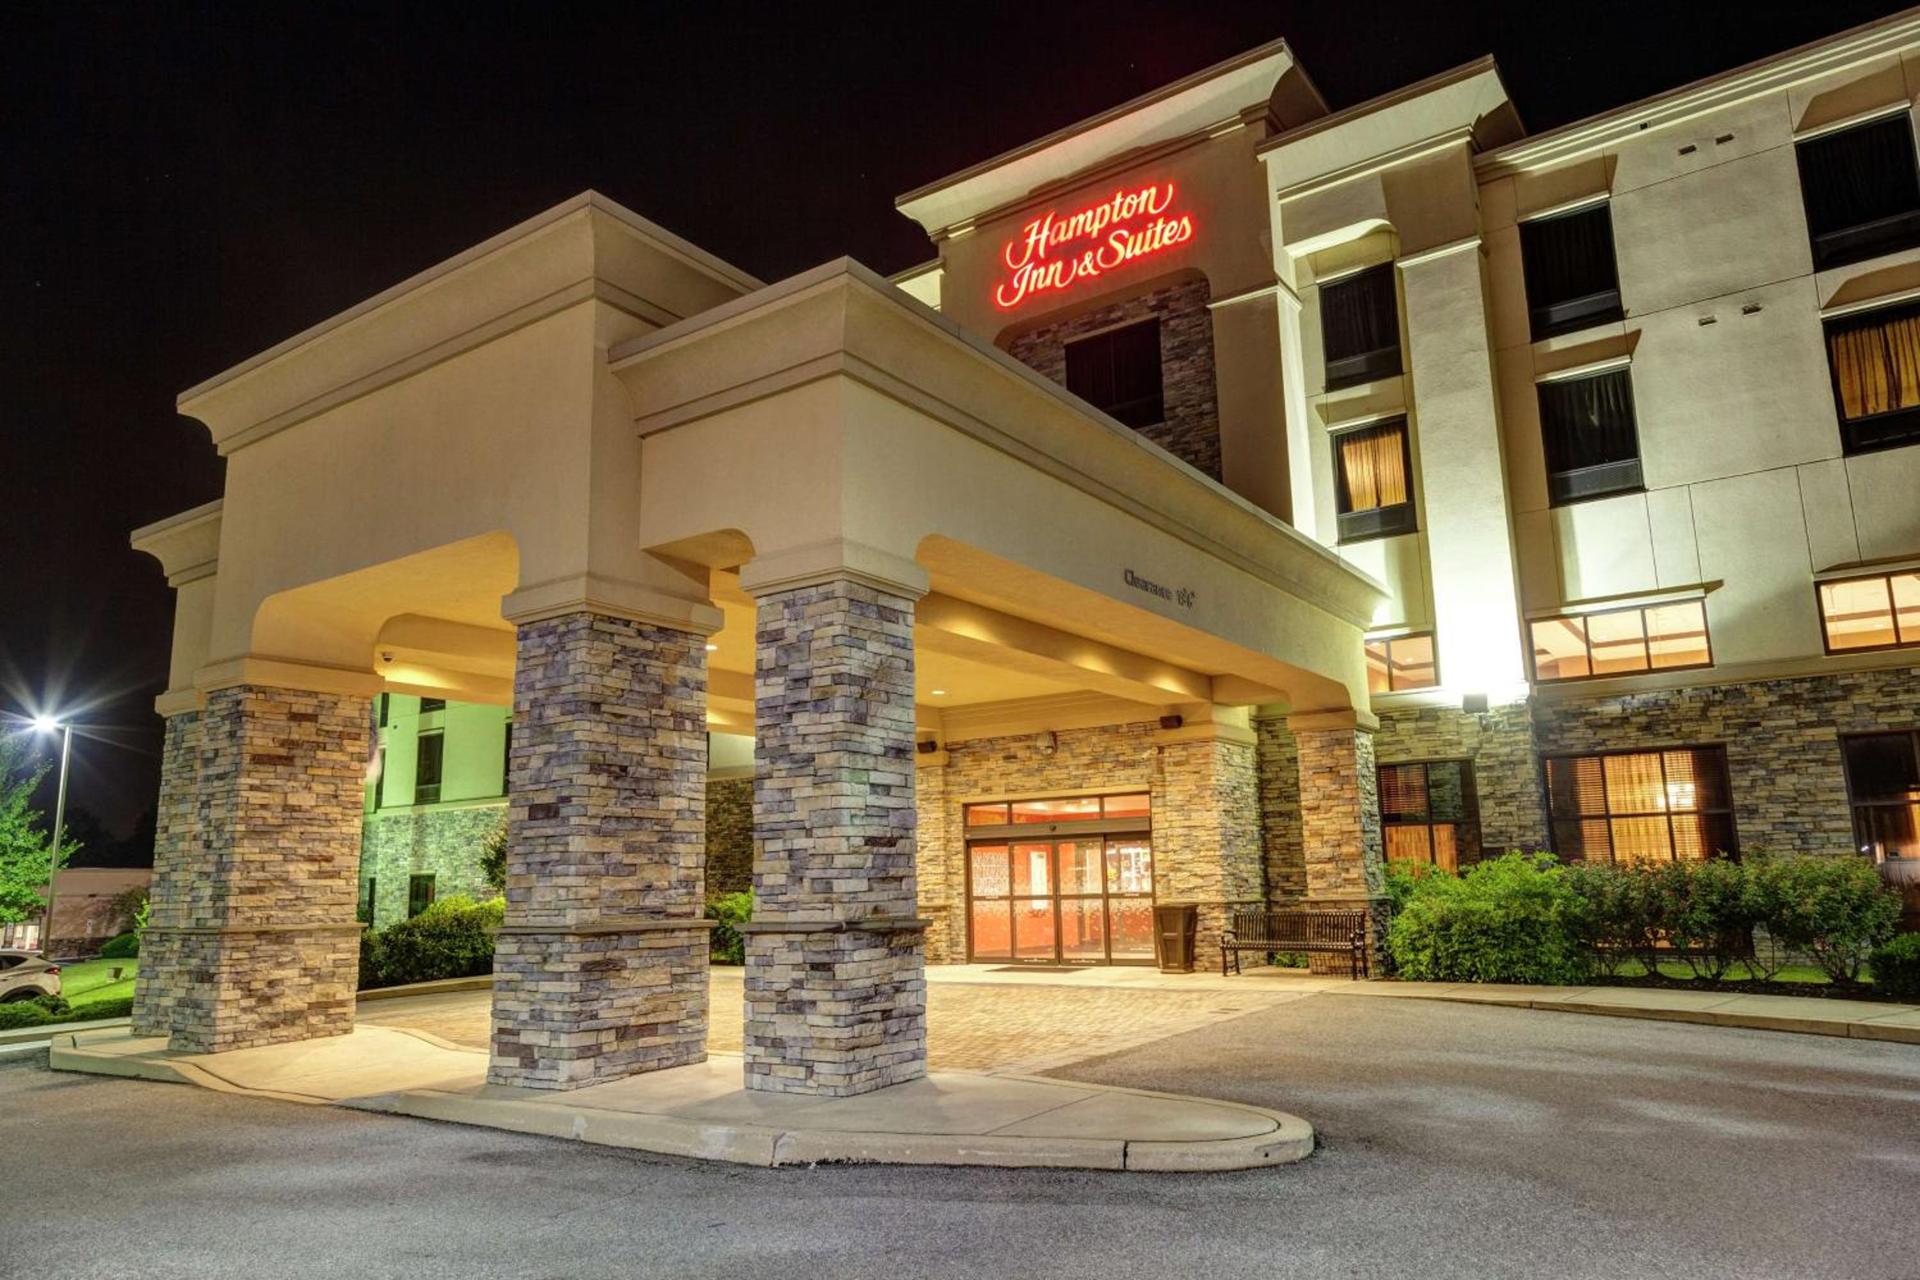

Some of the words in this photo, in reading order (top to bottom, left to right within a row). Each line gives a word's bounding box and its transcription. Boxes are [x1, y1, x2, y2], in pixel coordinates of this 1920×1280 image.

[997, 260, 1077, 306] Inn
[1078, 251, 1100, 276] &
[1097, 215, 1191, 268] Suites
[1006, 184, 1173, 268] Hampton
